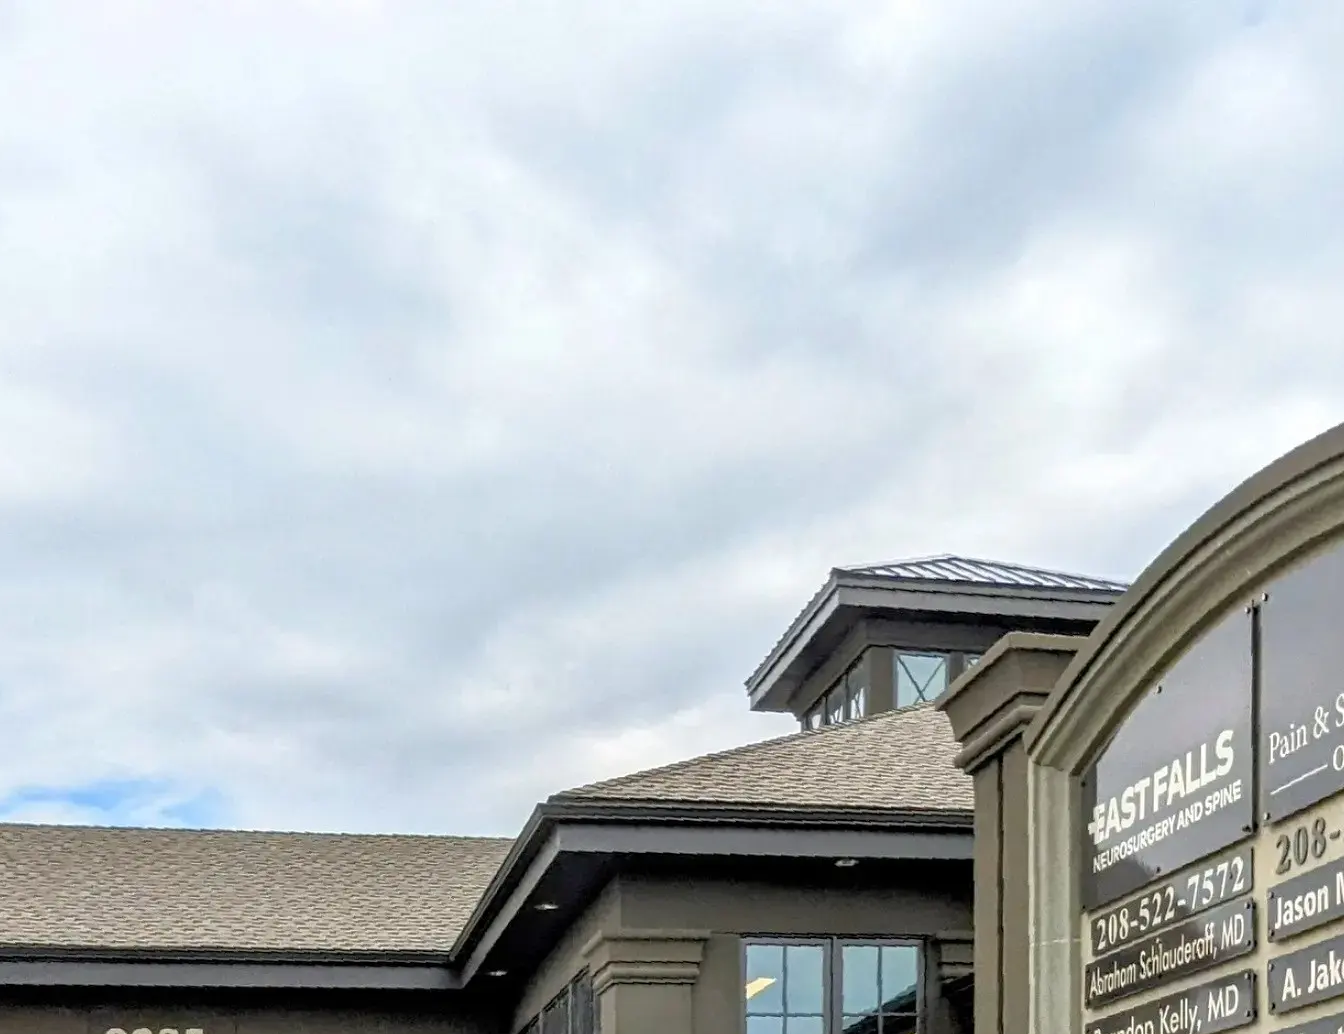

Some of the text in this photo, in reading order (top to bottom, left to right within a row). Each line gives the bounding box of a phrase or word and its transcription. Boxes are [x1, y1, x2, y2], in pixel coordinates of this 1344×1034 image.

[1268, 723, 1307, 764] Pain
[1312, 706, 1330, 740] &
[1088, 730, 1234, 845] EAST FALLS
[1093, 779, 1242, 873] NEUROSURGERY AND SPINE
[1097, 856, 1245, 950] 208-522-7572
[1274, 883, 1329, 930] Jason
[1089, 913, 1245, 999] Abraham Schlauderaff, MD
[1282, 968, 1302, 1002] A.
[1208, 984, 1239, 1022] MD
